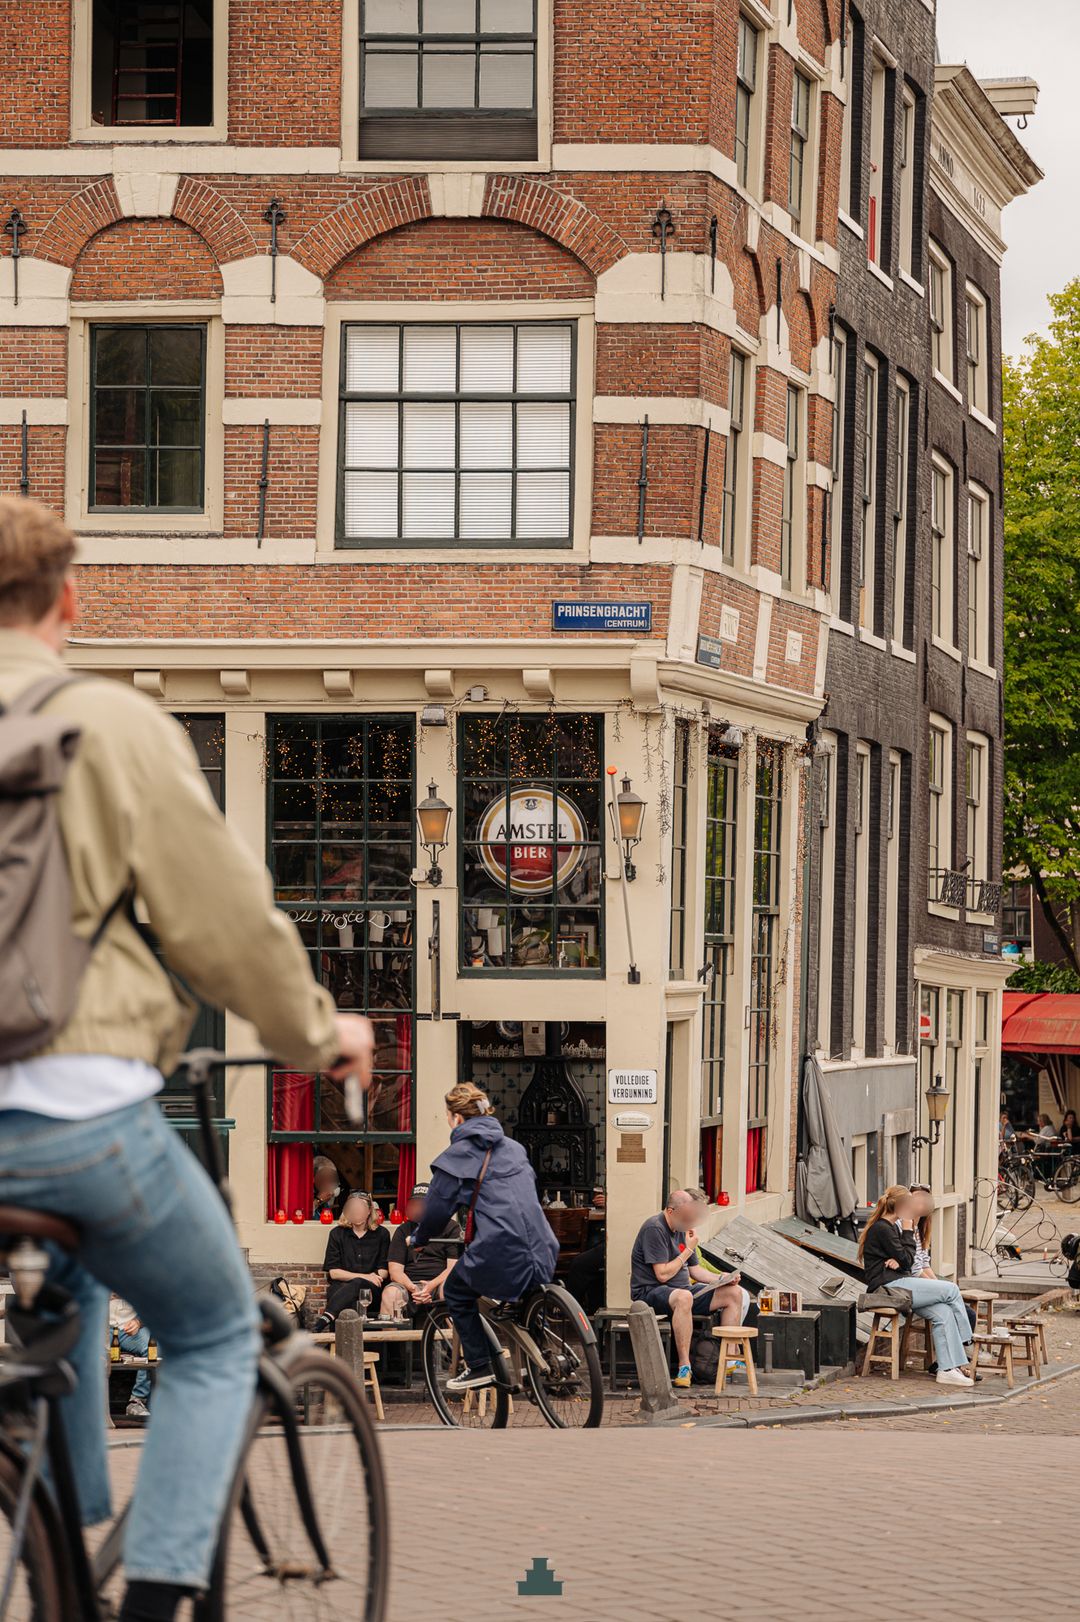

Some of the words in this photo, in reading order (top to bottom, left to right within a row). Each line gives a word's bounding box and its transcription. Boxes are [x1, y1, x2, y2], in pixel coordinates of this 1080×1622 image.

[557, 605, 647, 618] PRINSENGRACHT
[604, 619, 648, 628] (CENTRUM)
[495, 823, 567, 840] AMSTEL
[514, 846, 548, 859] BIER
[615, 1075, 650, 1086] VOLLEDIGE
[612, 1088, 653, 1099] VERGUNNING
